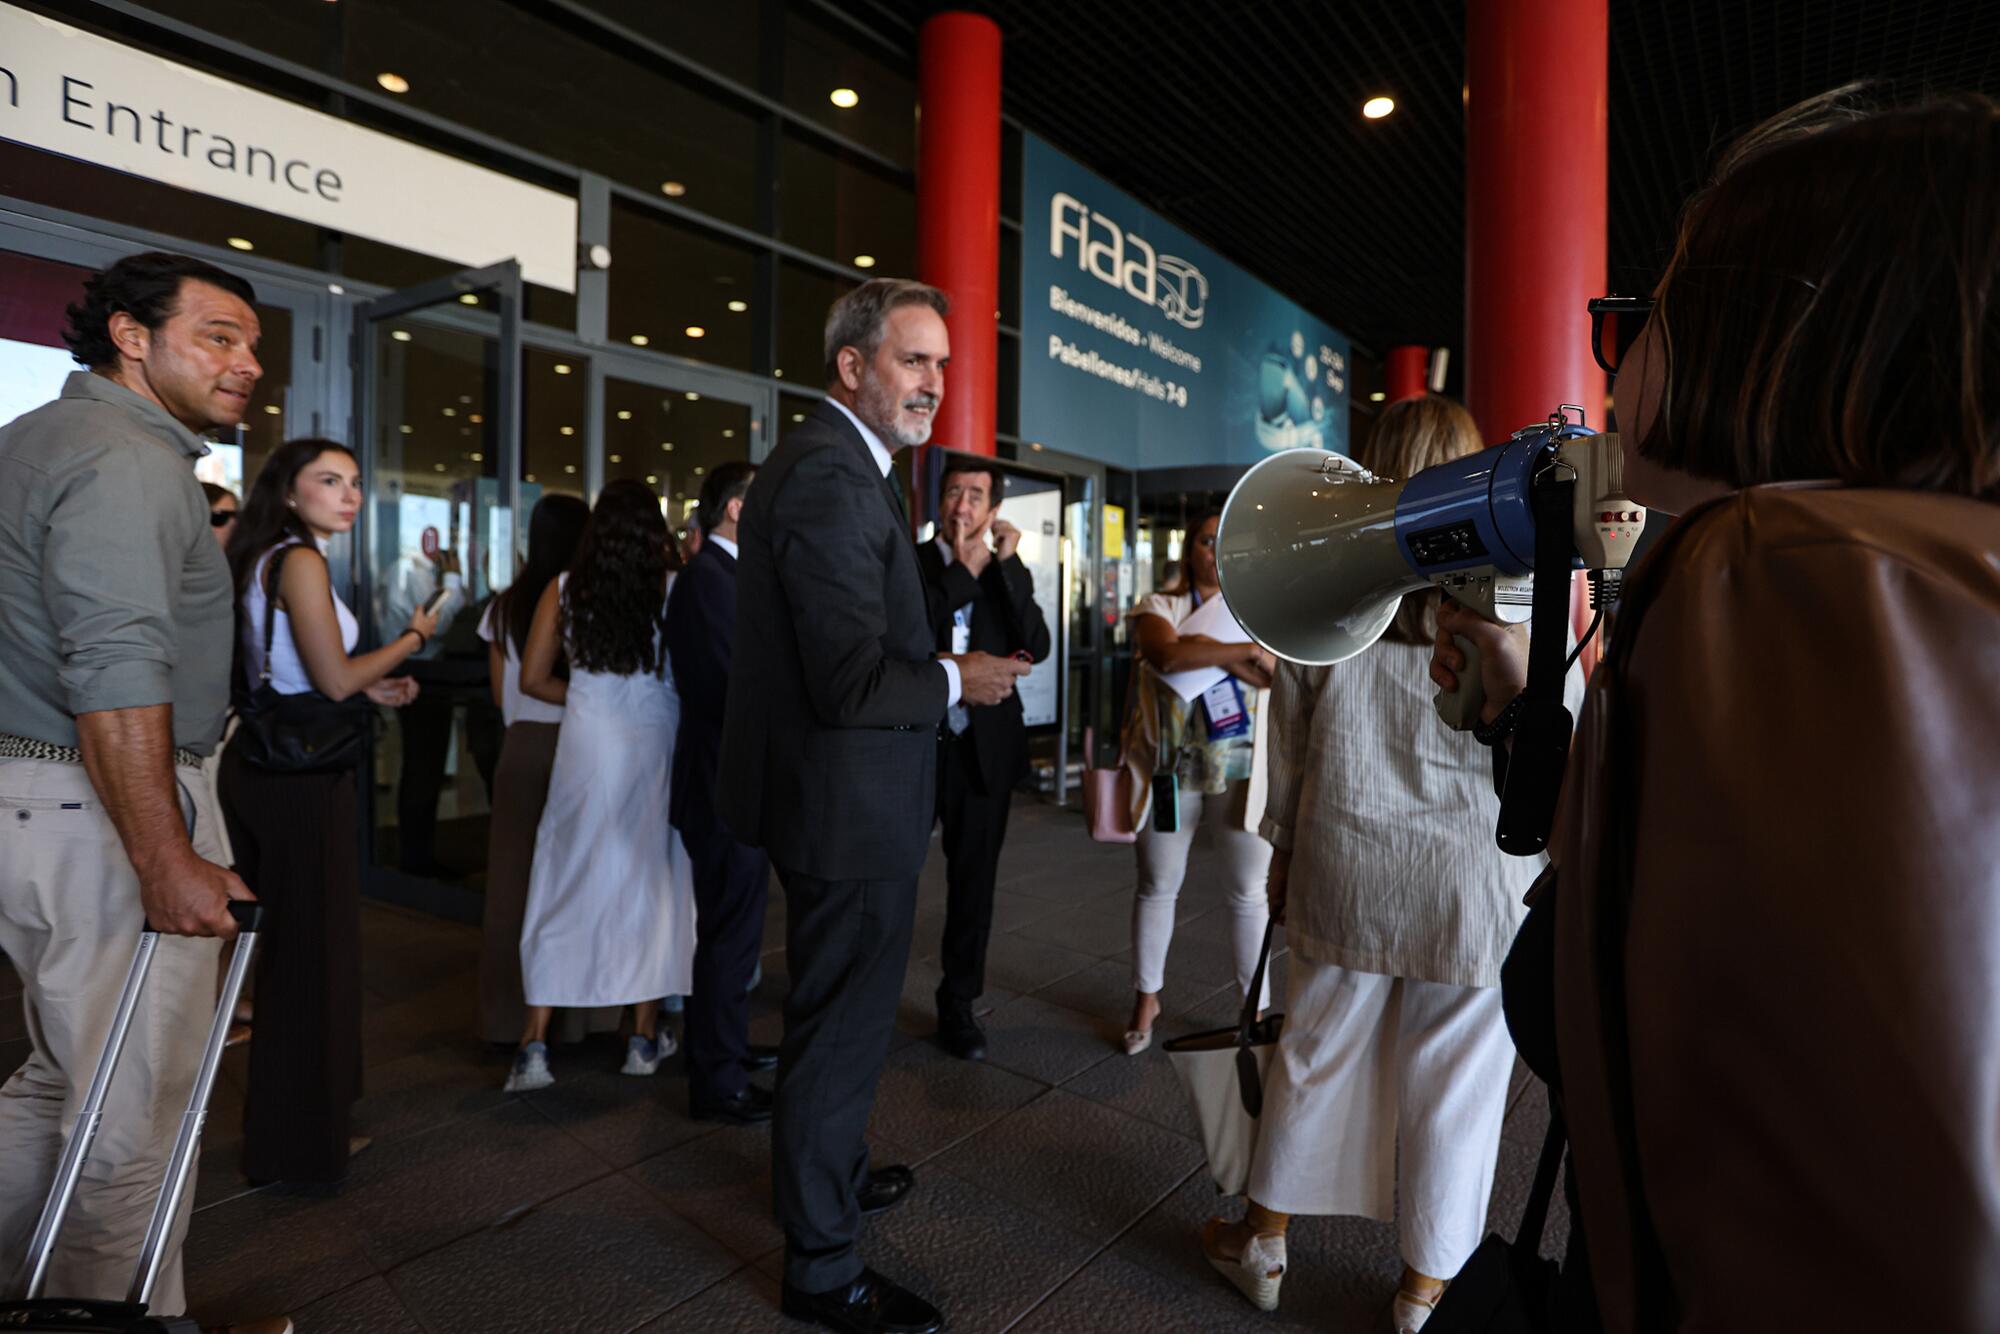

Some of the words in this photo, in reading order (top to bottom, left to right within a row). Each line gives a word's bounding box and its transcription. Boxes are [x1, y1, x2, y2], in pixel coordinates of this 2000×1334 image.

[61, 75, 342, 202] Entrance
[1050, 285, 1140, 346] Bienvenidos
[1148, 331, 1201, 373] Welcome
